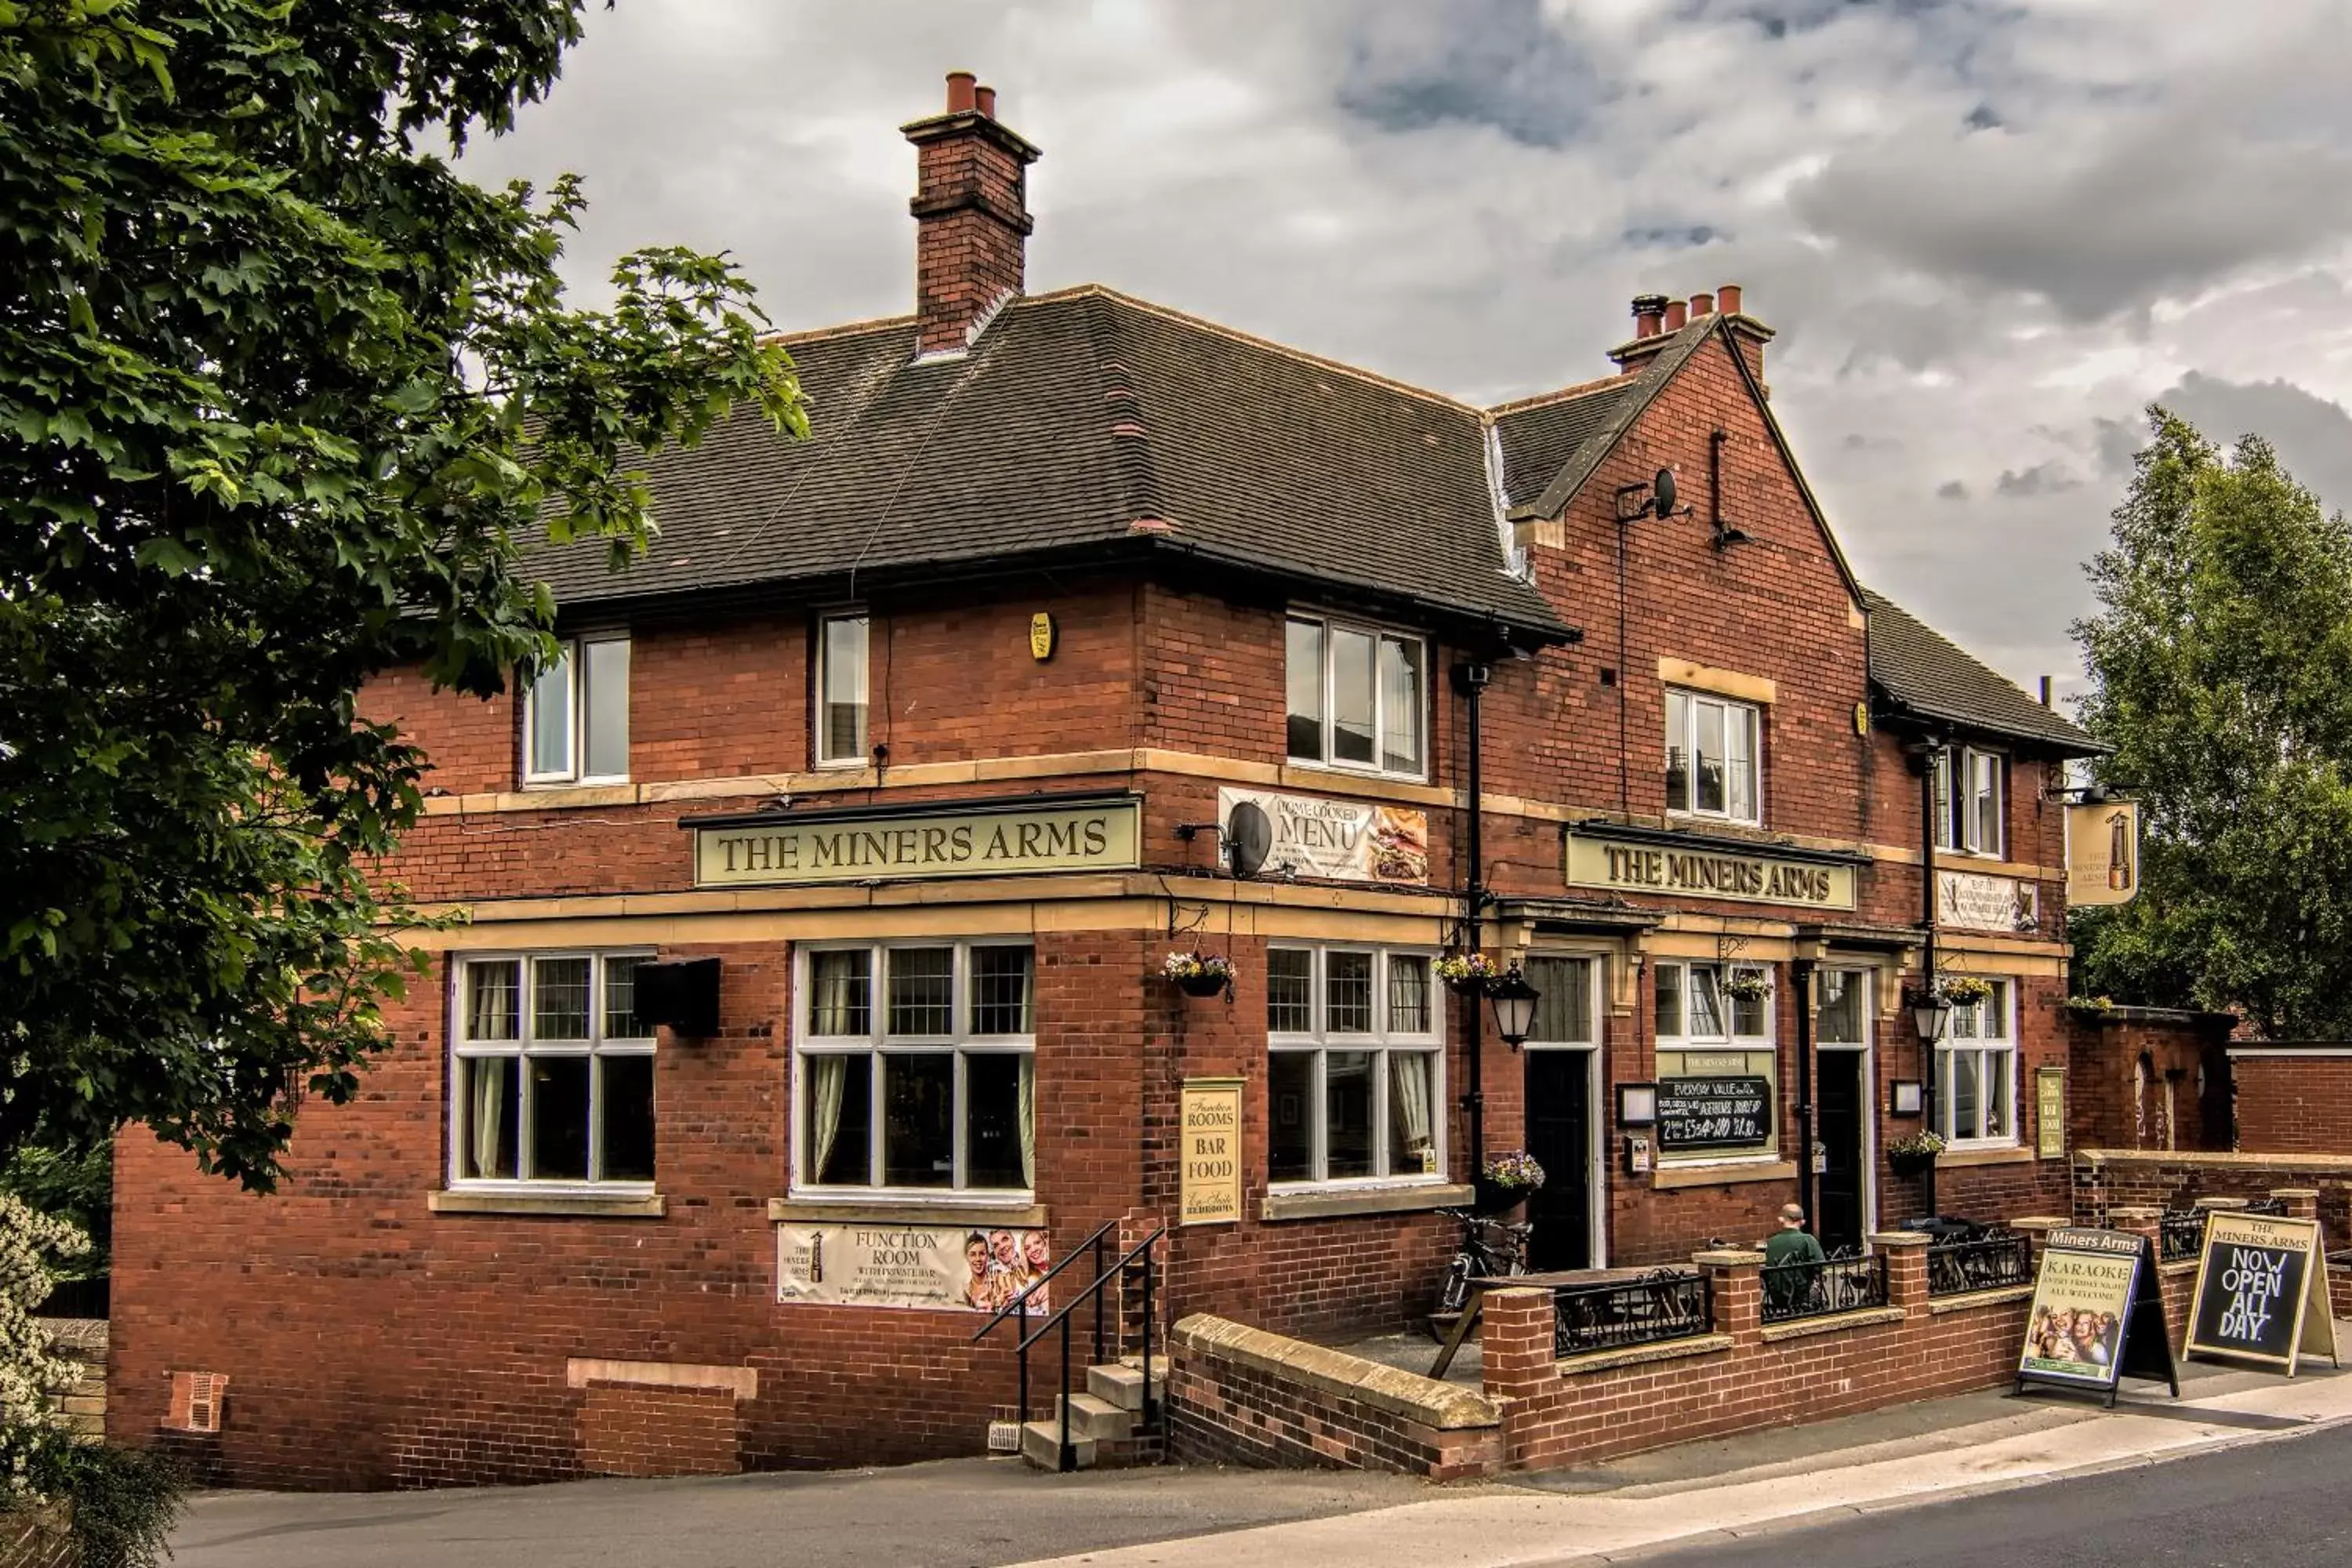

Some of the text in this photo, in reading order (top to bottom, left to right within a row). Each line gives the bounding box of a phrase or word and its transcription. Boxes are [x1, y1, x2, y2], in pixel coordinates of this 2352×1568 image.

[1276, 815, 1357, 851] MENU
[718, 816, 1108, 872] THE MINERS ARMS
[1604, 844, 1830, 901] THE MINERS ARMS
[1188, 1112, 1233, 1127] ROOMS
[1195, 1138, 1225, 1156] BAR
[1188, 1160, 1232, 1179] FOOD
[2251, 1222, 2275, 1235] THE
[856, 1232, 938, 1249] FUNCTION
[2050, 1230, 2139, 1252] Miners Arms
[2214, 1230, 2308, 1250] MINERS ARMS
[873, 1249, 920, 1266] ROOM
[2232, 1247, 2287, 1274] NOW
[2047, 1261, 2129, 1280] KARAOKE
[2222, 1269, 2282, 1298] OPEN
[2229, 1292, 2270, 1319] ALL
[2218, 1312, 2262, 1341] DAY.
